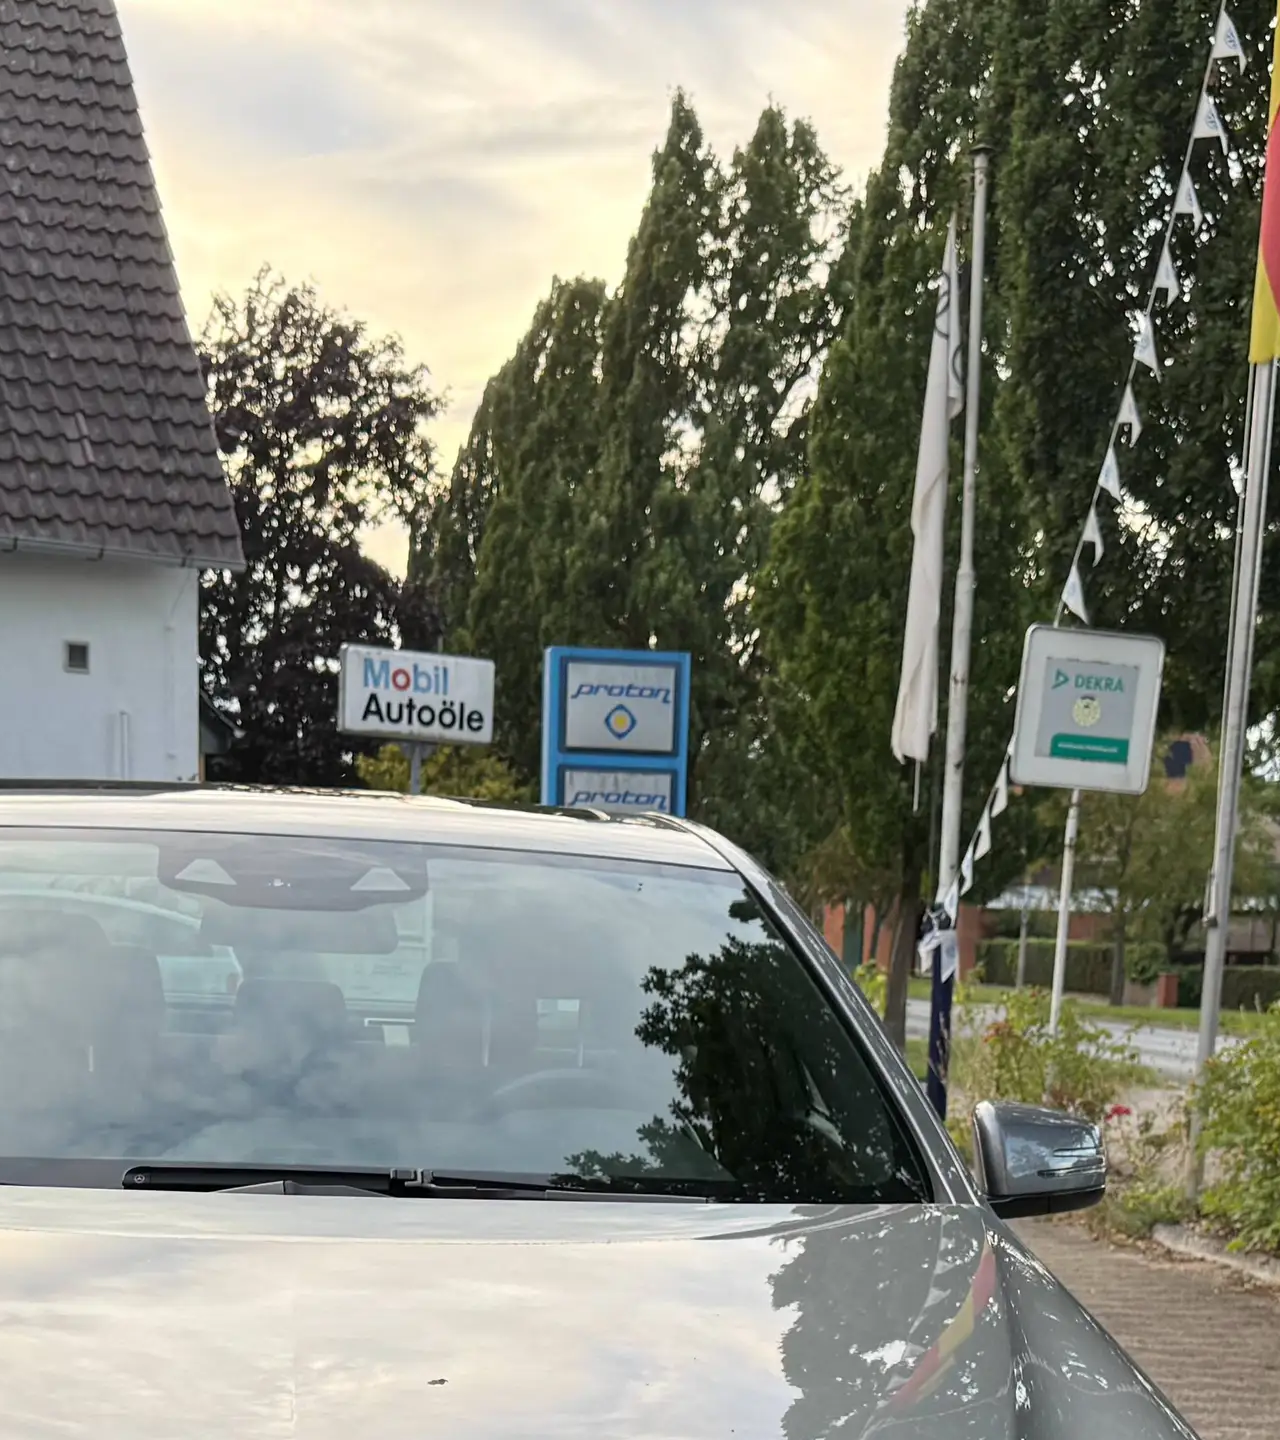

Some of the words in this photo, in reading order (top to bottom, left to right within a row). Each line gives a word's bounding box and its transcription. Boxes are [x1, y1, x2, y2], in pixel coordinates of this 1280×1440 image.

[363, 657, 449, 695] Mobil
[1074, 673, 1124, 693] DEKRA
[569, 683, 671, 704] proton
[362, 692, 485, 732] Autoöle
[567, 790, 668, 810] proton
